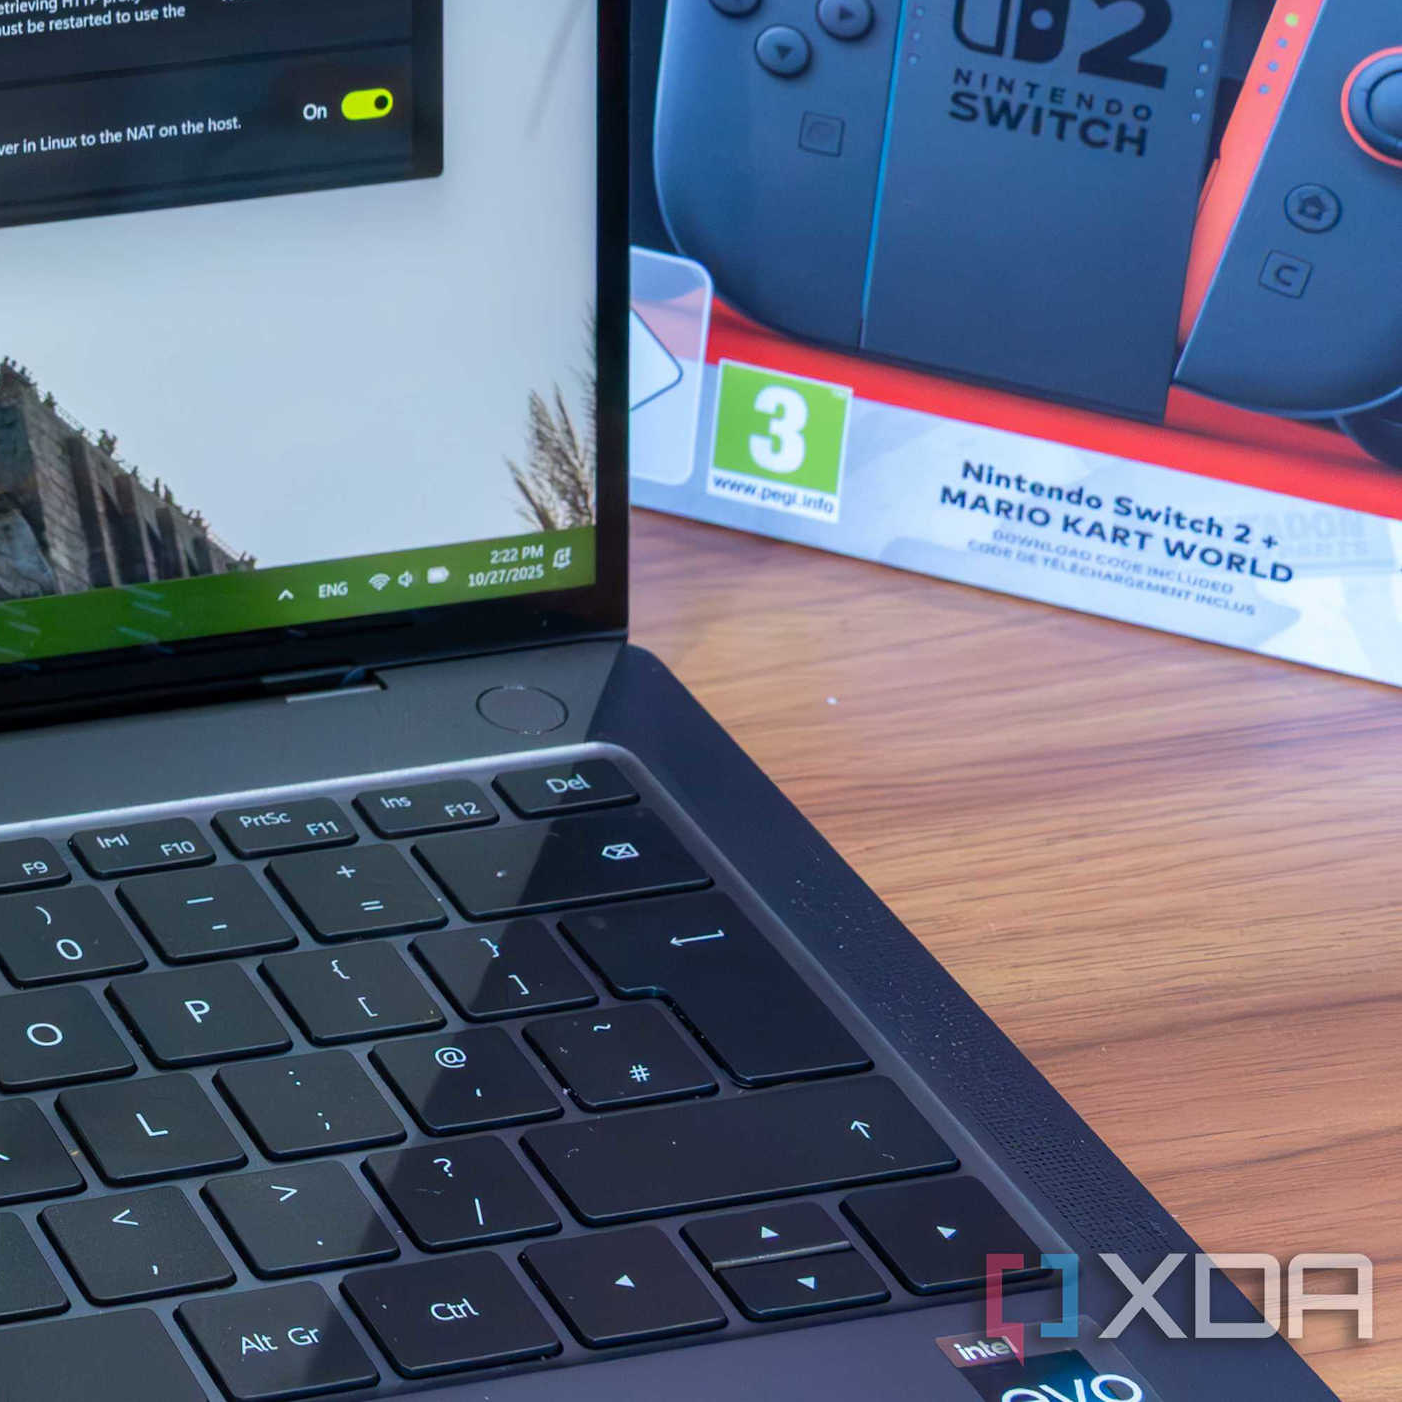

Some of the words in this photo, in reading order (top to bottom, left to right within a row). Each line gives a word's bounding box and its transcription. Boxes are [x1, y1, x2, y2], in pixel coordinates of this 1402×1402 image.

[951, 65, 1154, 124] NINTENDO
[303, 104, 327, 120] On
[950, 88, 1152, 156] SWITCH
[1275, 265, 1298, 286] C
[749, 384, 808, 473] 3
[714, 475, 834, 513] www.pegi.info
[962, 461, 1102, 510] Nintendo
[1113, 495, 1223, 538] Switch
[1234, 524, 1252, 544] 2
[1262, 534, 1279, 549] +
[940, 486, 1051, 527] MARIO
[1062, 509, 1152, 551] KART
[1164, 537, 1294, 583] WORLD
[491, 548, 518, 563] 2:22
[522, 545, 543, 559] PM
[992, 529, 1091, 561] DOWNLOAD
[1095, 553, 1143, 571] CODE
[1147, 564, 1233, 594] INCLUDED
[468, 564, 544, 587] 10/27/2025
[967, 540, 1011, 559] CODE
[1015, 551, 1038, 565] DE
[1042, 554, 1190, 601] TÉLÉCHARGEMENT
[1195, 592, 1255, 616] INCLUS
[319, 582, 348, 598] ENG
[546, 774, 590, 793] Del
[380, 795, 412, 810] Ins
[240, 812, 291, 827] PrtSc
[431, 1299, 478, 1320] Ctrl
[242, 1334, 277, 1354] Alt
[288, 1328, 318, 1345] Gr
[953, 1336, 1019, 1362] intel
